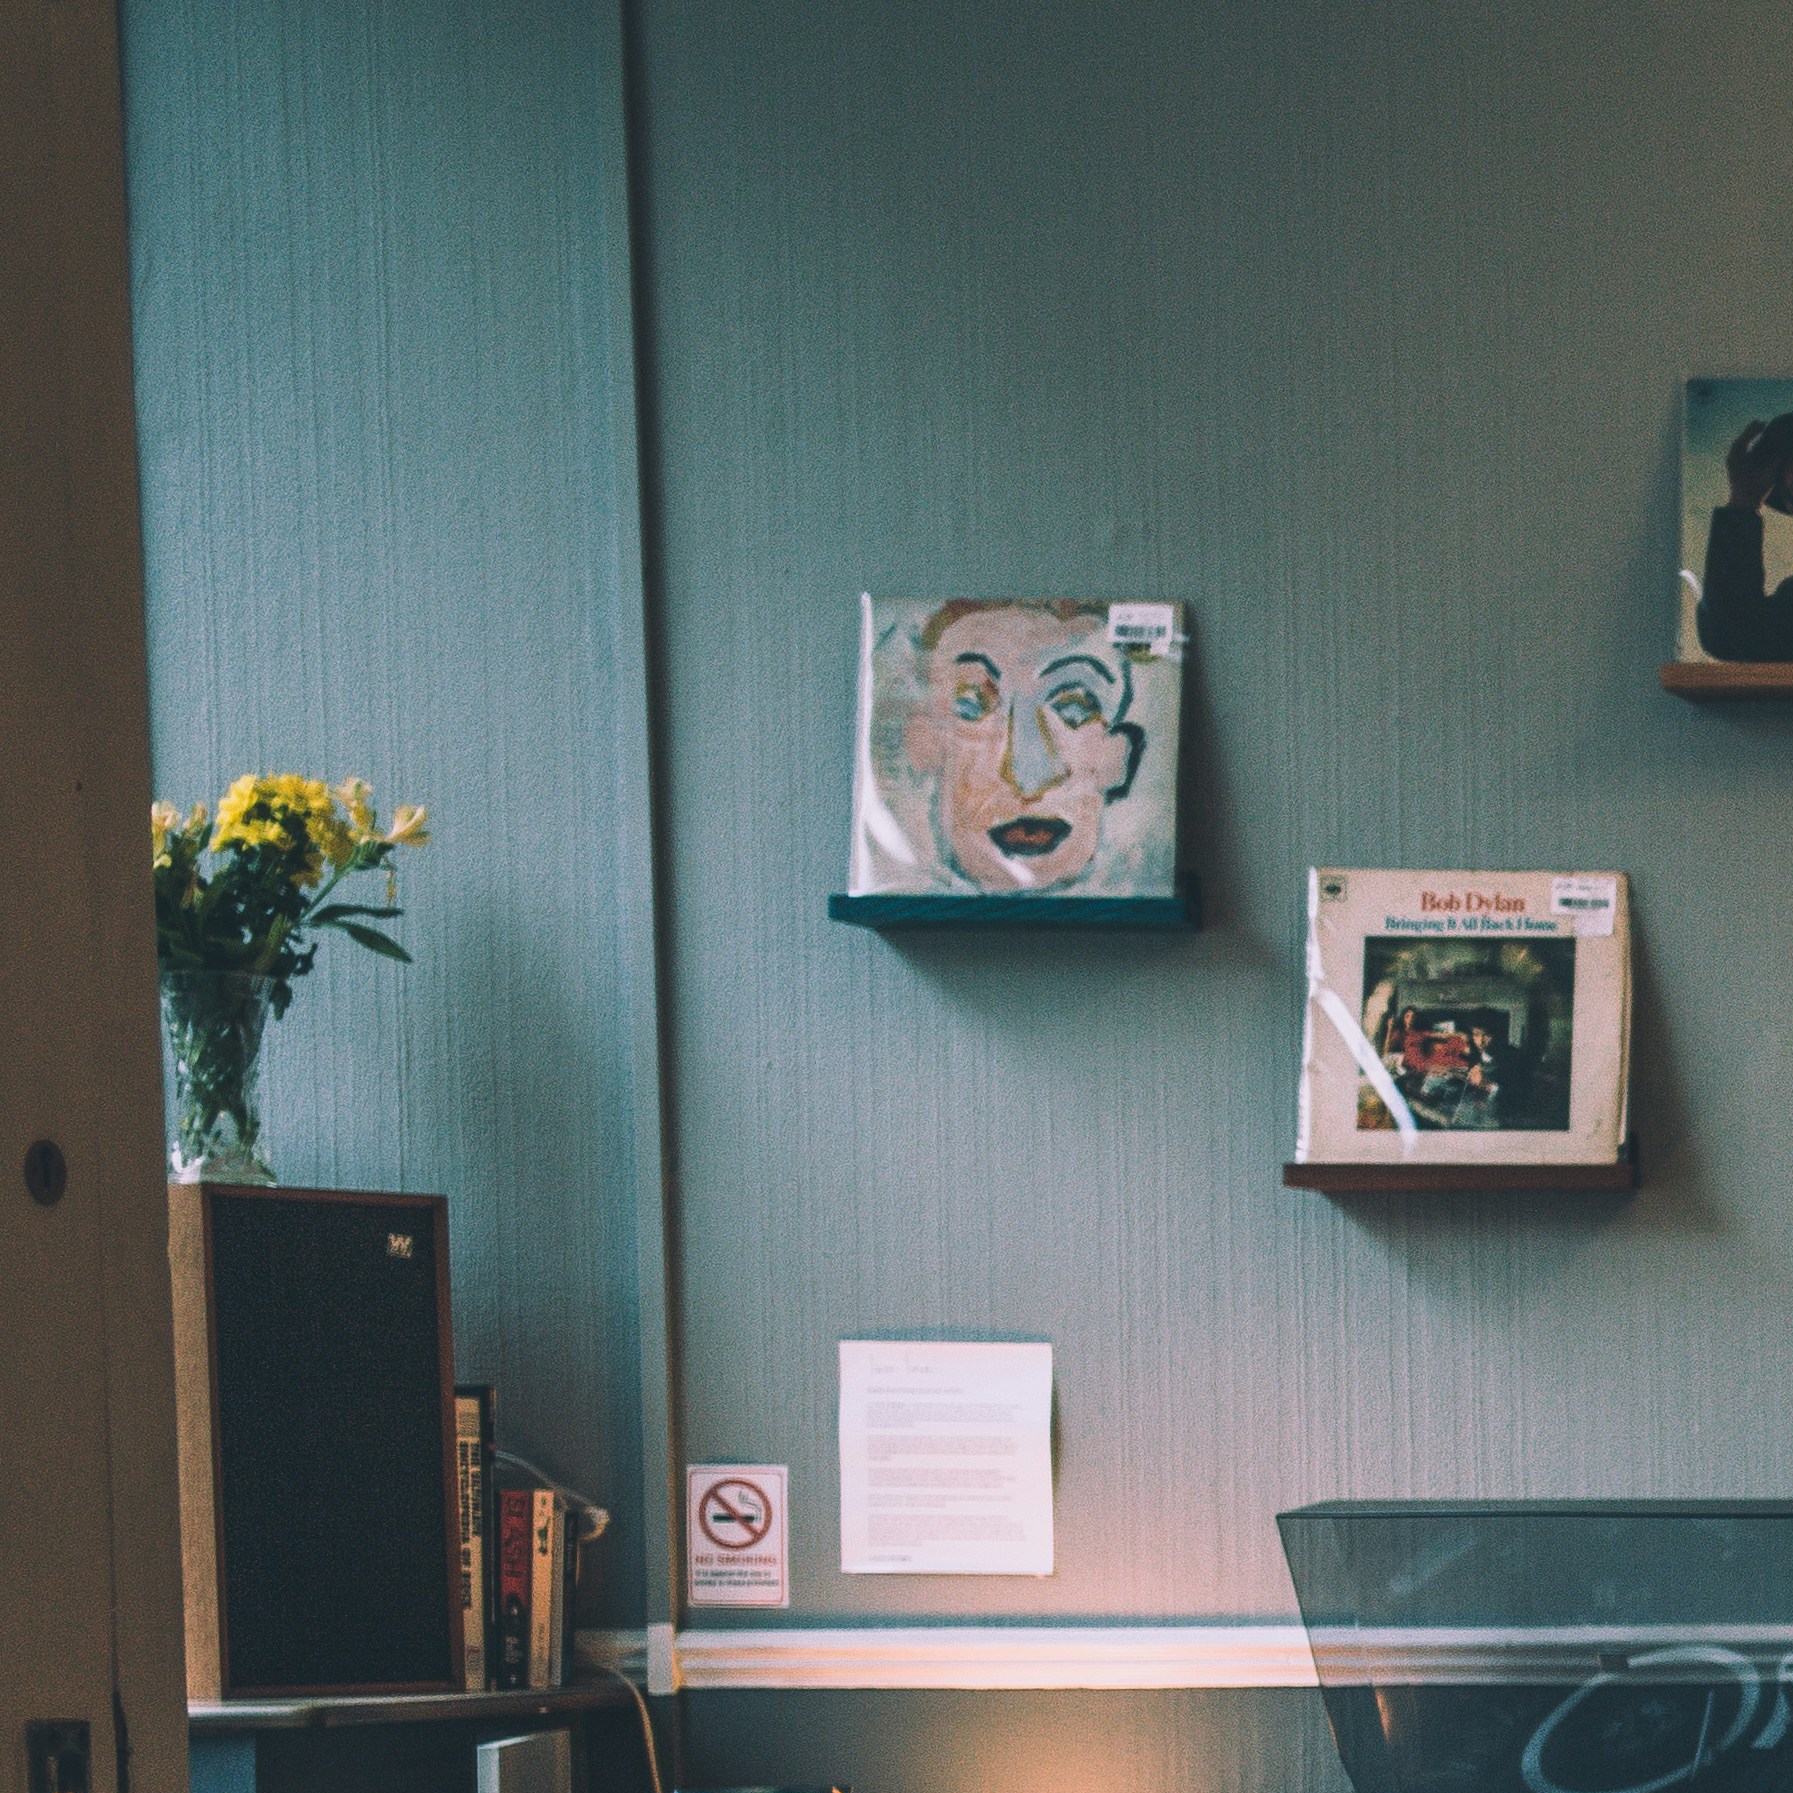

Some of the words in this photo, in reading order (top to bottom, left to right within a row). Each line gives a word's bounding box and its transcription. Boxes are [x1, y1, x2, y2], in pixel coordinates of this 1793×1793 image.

[1420, 891, 1460, 913] Bob
[1465, 892, 1526, 914] Dylan
[1385, 916, 1444, 933] Bringing
[1458, 917, 1477, 931] All
[1479, 917, 1513, 932] Back
[1516, 918, 1558, 932] Home
